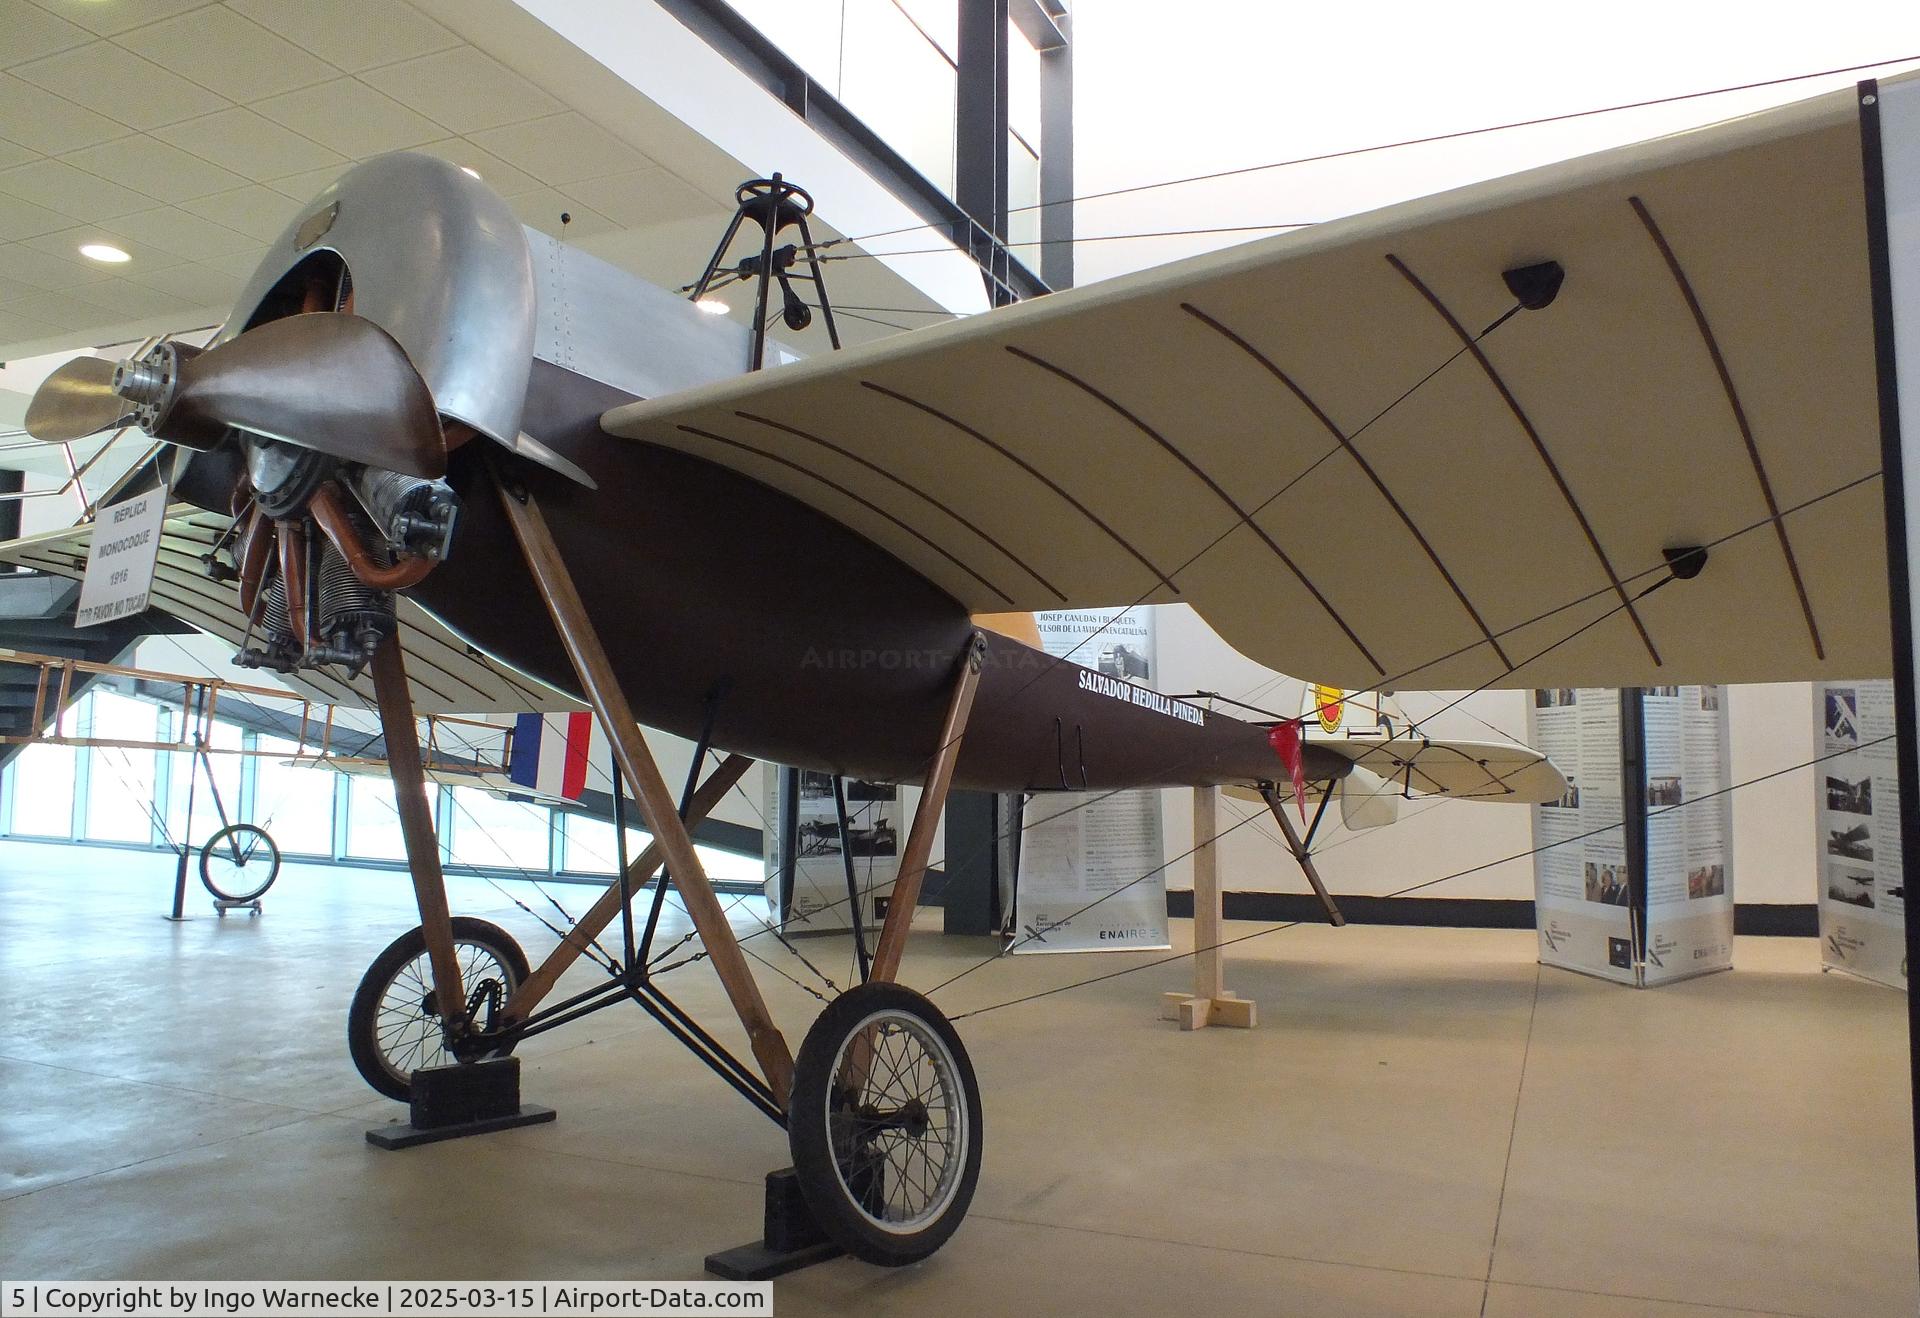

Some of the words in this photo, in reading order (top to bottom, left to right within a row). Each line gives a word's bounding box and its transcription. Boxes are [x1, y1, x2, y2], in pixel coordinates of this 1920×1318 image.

[98, 529, 151, 559] MONOCOQUE
[110, 568, 129, 586] 1916
[94, 603, 113, 619] FAVOR
[114, 600, 124, 616] NO
[1040, 613, 1063, 622] JOSEP
[1064, 613, 1097, 623] CANUDAS
[1063, 624, 1072, 633] DE
[1073, 625, 1081, 633] LA
[1078, 669, 1131, 703] SALVADOR
[1132, 686, 1171, 716] HEDILLA
[1172, 700, 1205, 727] PINEDA
